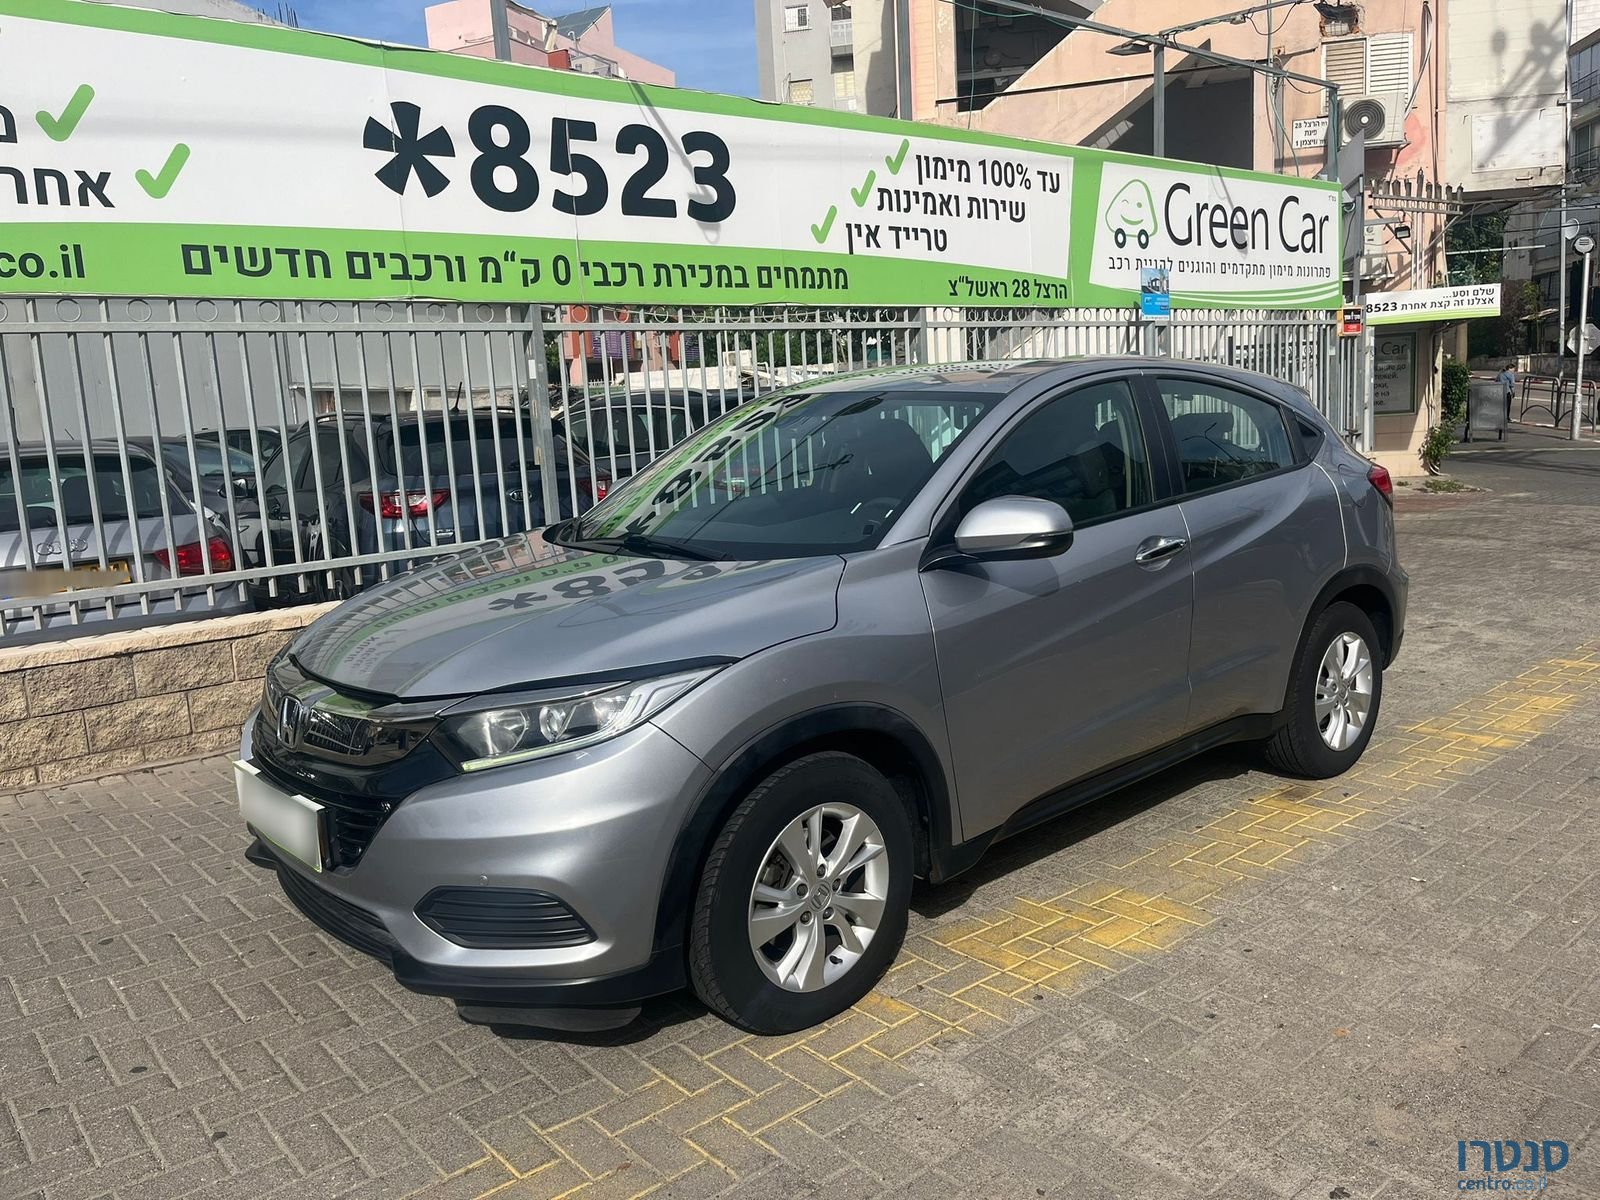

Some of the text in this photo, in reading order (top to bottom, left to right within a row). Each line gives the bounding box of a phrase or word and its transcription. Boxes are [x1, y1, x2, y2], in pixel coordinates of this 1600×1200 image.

[915, 154, 1061, 194] עד 100% מימון
[877, 187, 1026, 223] שירות ואמינות
[1164, 182, 1329, 254] Green Car
[845, 223, 947, 255] טרייד אין
[181, 243, 332, 279] חדשים
[345, 251, 467, 283] ורכבים
[552, 254, 571, 286] 0
[1108, 256, 1131, 271] רכב
[1178, 259, 1216, 275] והוגנים
[1220, 261, 1266, 278] מתקדמים
[1269, 262, 1294, 279] מימון
[1296, 264, 1331, 279] פתרונות
[579, 261, 645, 287] רכבי
[652, 263, 750, 289] במכירת
[756, 265, 849, 290] מתמחים
[1011, 278, 1030, 298] 28
[1033, 278, 1068, 300] הרצל
[1472, 287, 1495, 297] שלם
[1366, 297, 1495, 314] אצלנו זה קצת אחרת 8523
[1381, 341, 1407, 355] Car
